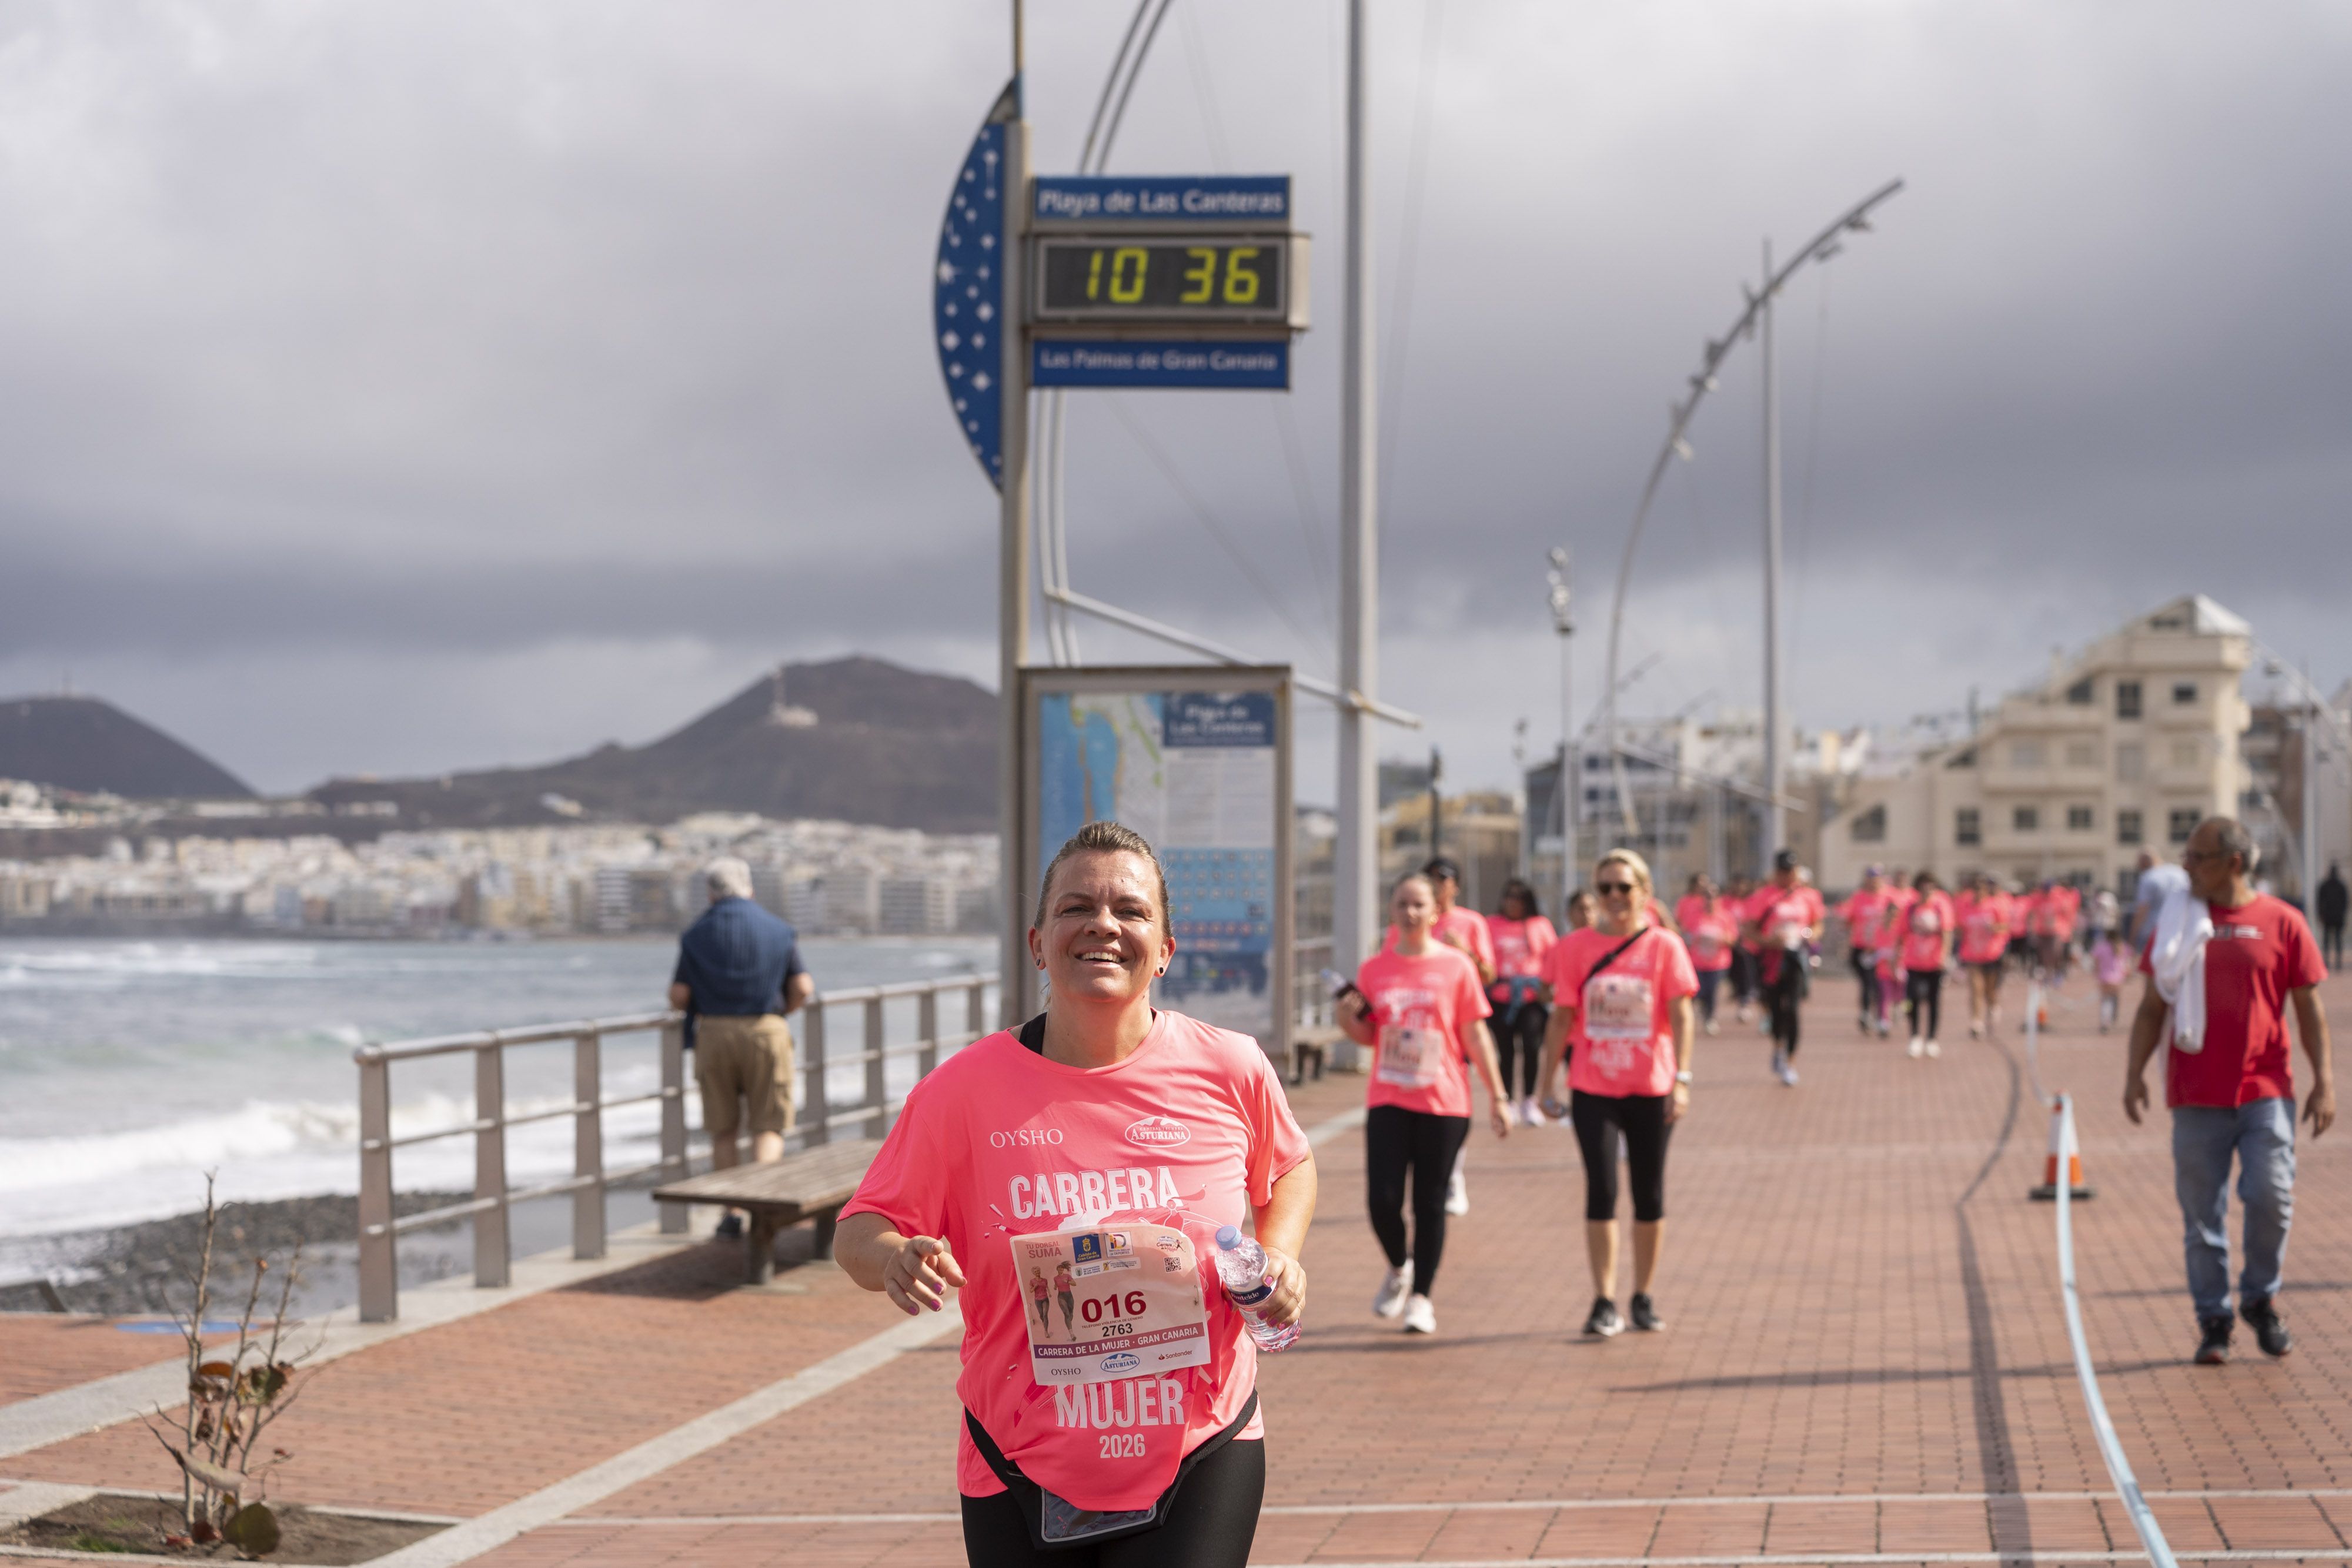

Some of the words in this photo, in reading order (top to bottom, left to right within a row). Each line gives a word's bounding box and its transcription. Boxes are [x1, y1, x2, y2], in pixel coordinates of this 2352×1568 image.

[1038, 189, 1101, 218] Playa
[1104, 189, 1136, 213] de
[1140, 189, 1178, 213] Las
[1182, 189, 1284, 213] Canteras
[1087, 247, 1149, 303] 10
[1180, 247, 1259, 303] 36
[1040, 349, 1070, 369] Las
[1073, 349, 1134, 370] Palmas
[1136, 350, 1160, 370] de
[1162, 349, 1207, 370] Gran
[1209, 349, 1278, 370] Canaria
[990, 1129, 1063, 1148] OYSHO
[1131, 1128, 1187, 1140] ASTURIANA
[1008, 1166, 1184, 1220] CARRERA
[1028, 1248, 1062, 1259] SUMA
[1081, 1290, 1147, 1323] 016
[1102, 1323, 1133, 1337] 2763
[1038, 1348, 1074, 1356] CARRERA
[1089, 1344, 1100, 1352] LA
[1102, 1339, 1130, 1350] MUJER
[1138, 1334, 1160, 1345] GRAN
[1162, 1326, 1198, 1340] CANARIA
[1104, 1360, 1137, 1369] ASTURIANA
[1165, 1349, 1193, 1359] Santander
[1051, 1368, 1081, 1376] OYSHO
[1053, 1378, 1185, 1429] MUJER
[1099, 1433, 1146, 1459] 2026
